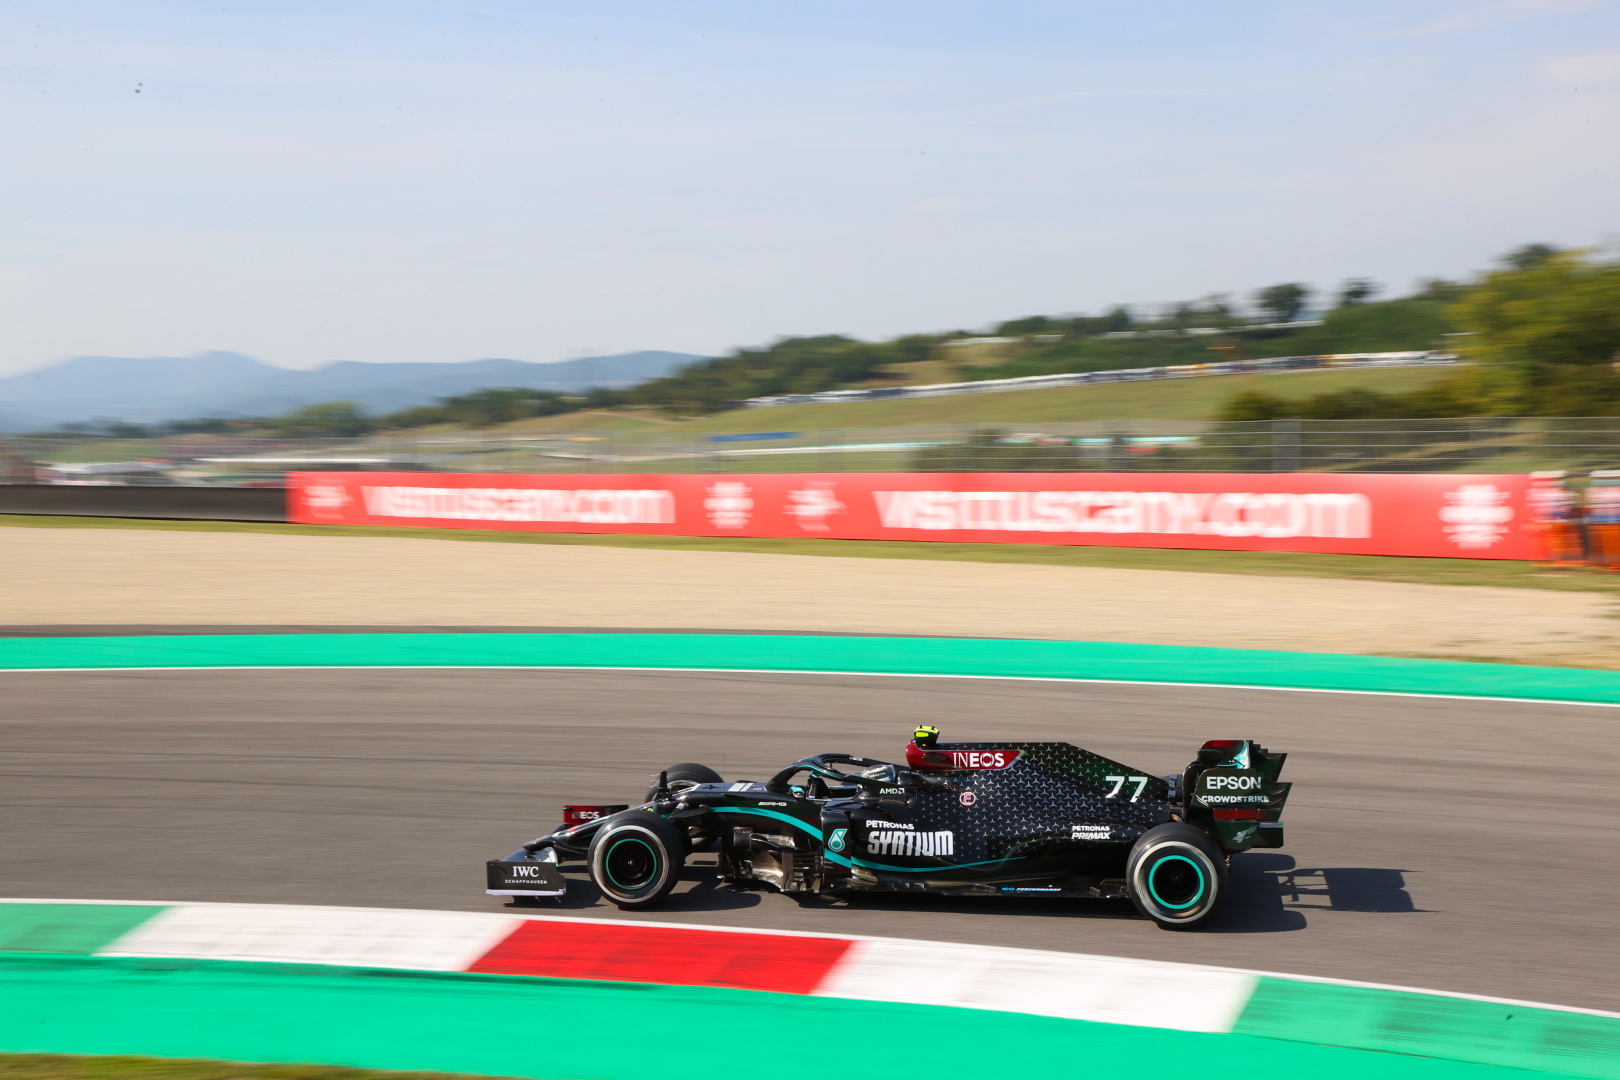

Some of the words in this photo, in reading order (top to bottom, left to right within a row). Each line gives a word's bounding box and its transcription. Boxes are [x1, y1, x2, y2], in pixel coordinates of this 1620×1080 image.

[952, 751, 1005, 768] INEOS
[1206, 776, 1262, 790] EPSON
[1105, 775, 1148, 803] 77
[1201, 795, 1270, 803] CROWDSTRIKE
[571, 811, 600, 820] INEOS
[865, 820, 915, 830] PETRONAS
[1071, 832, 1110, 840] PRIMAX
[867, 830, 954, 857] SYNTIUM
[512, 866, 540, 877] IWC
